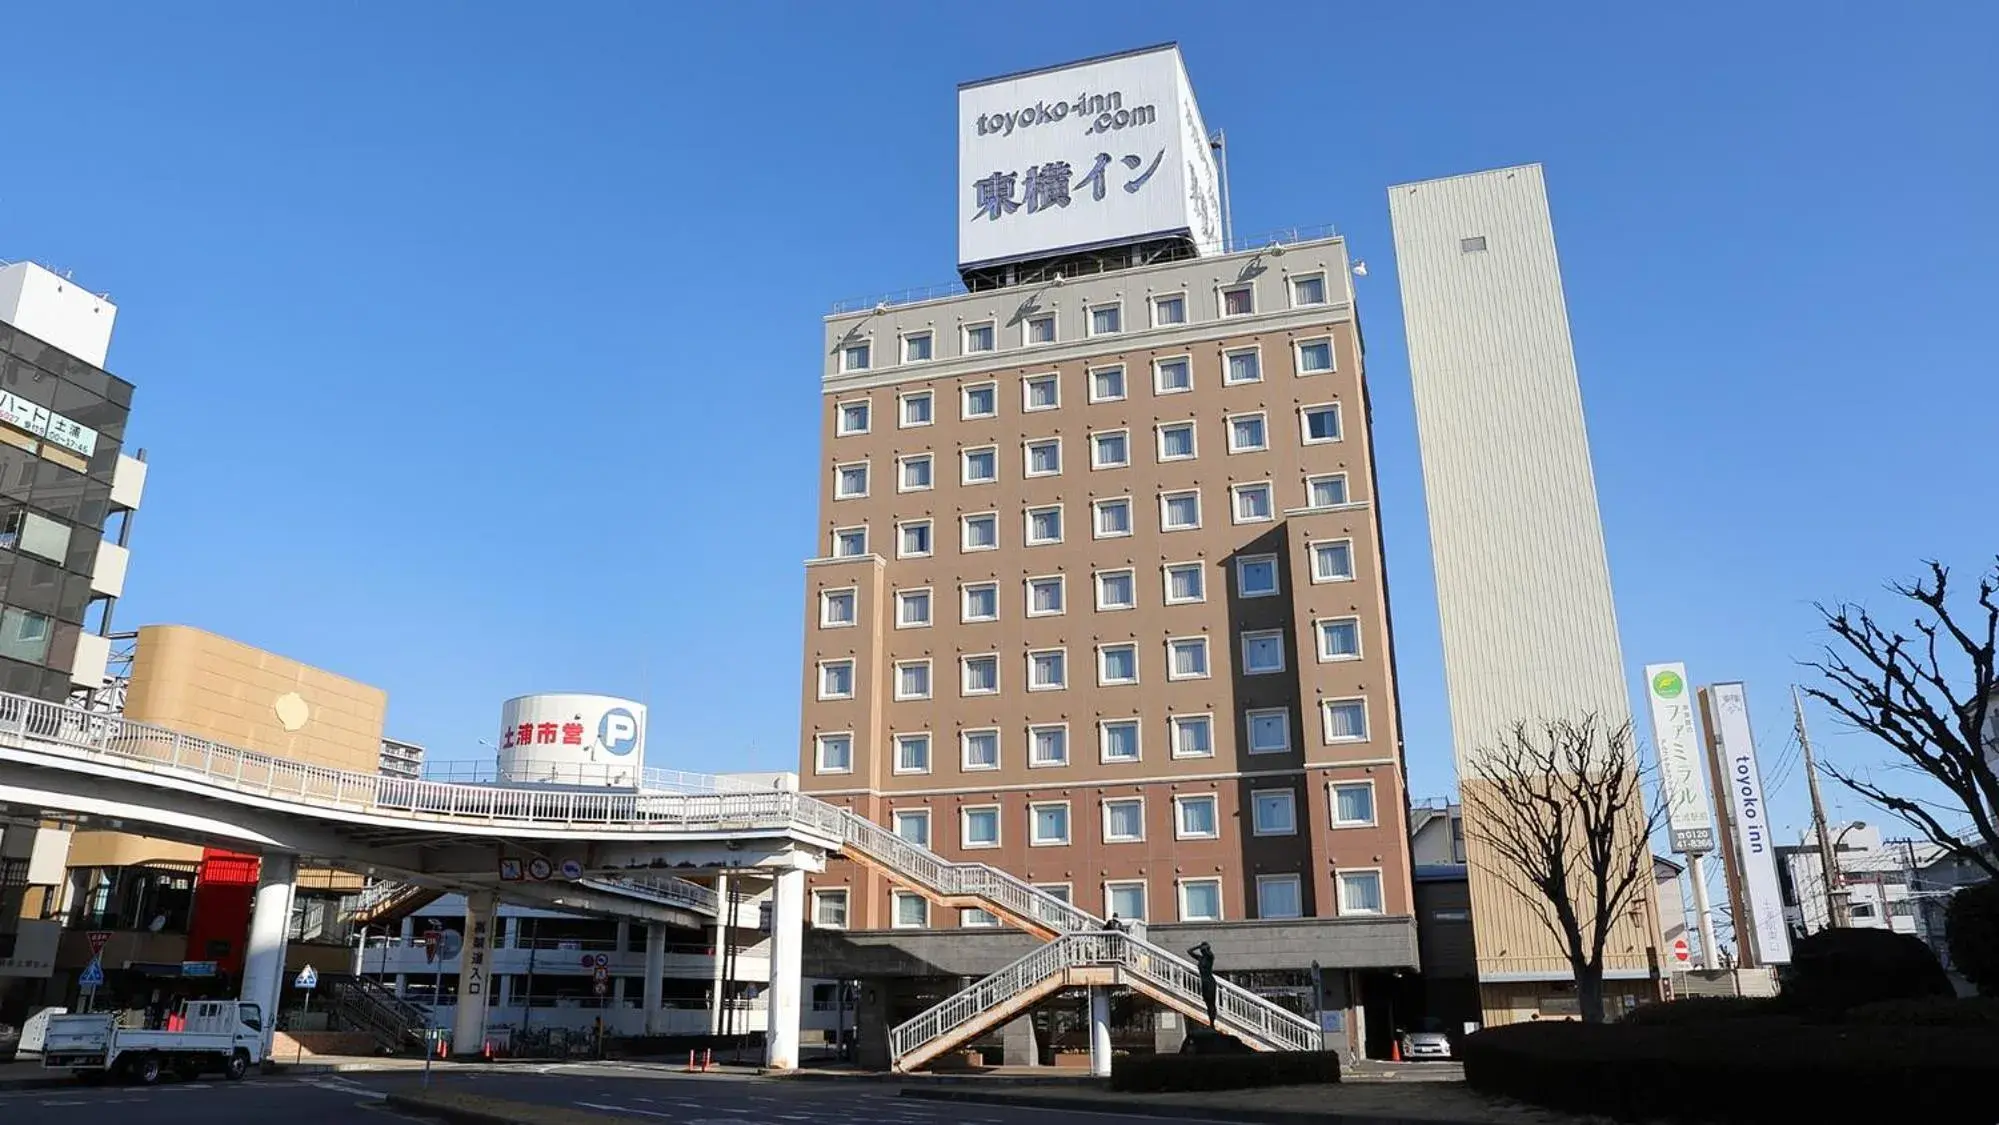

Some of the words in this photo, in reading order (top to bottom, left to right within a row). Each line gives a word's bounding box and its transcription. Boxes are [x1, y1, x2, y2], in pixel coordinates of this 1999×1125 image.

[975, 90, 1122, 137] toyoko-inn
[1085, 103, 1156, 136] .com
[970, 144, 1166, 221] 東横イン
[503, 722, 584, 749] 土浦市営
[606, 713, 635, 748] P
[1736, 756, 1758, 819] toyoko
[1748, 825, 1763, 854] inn
